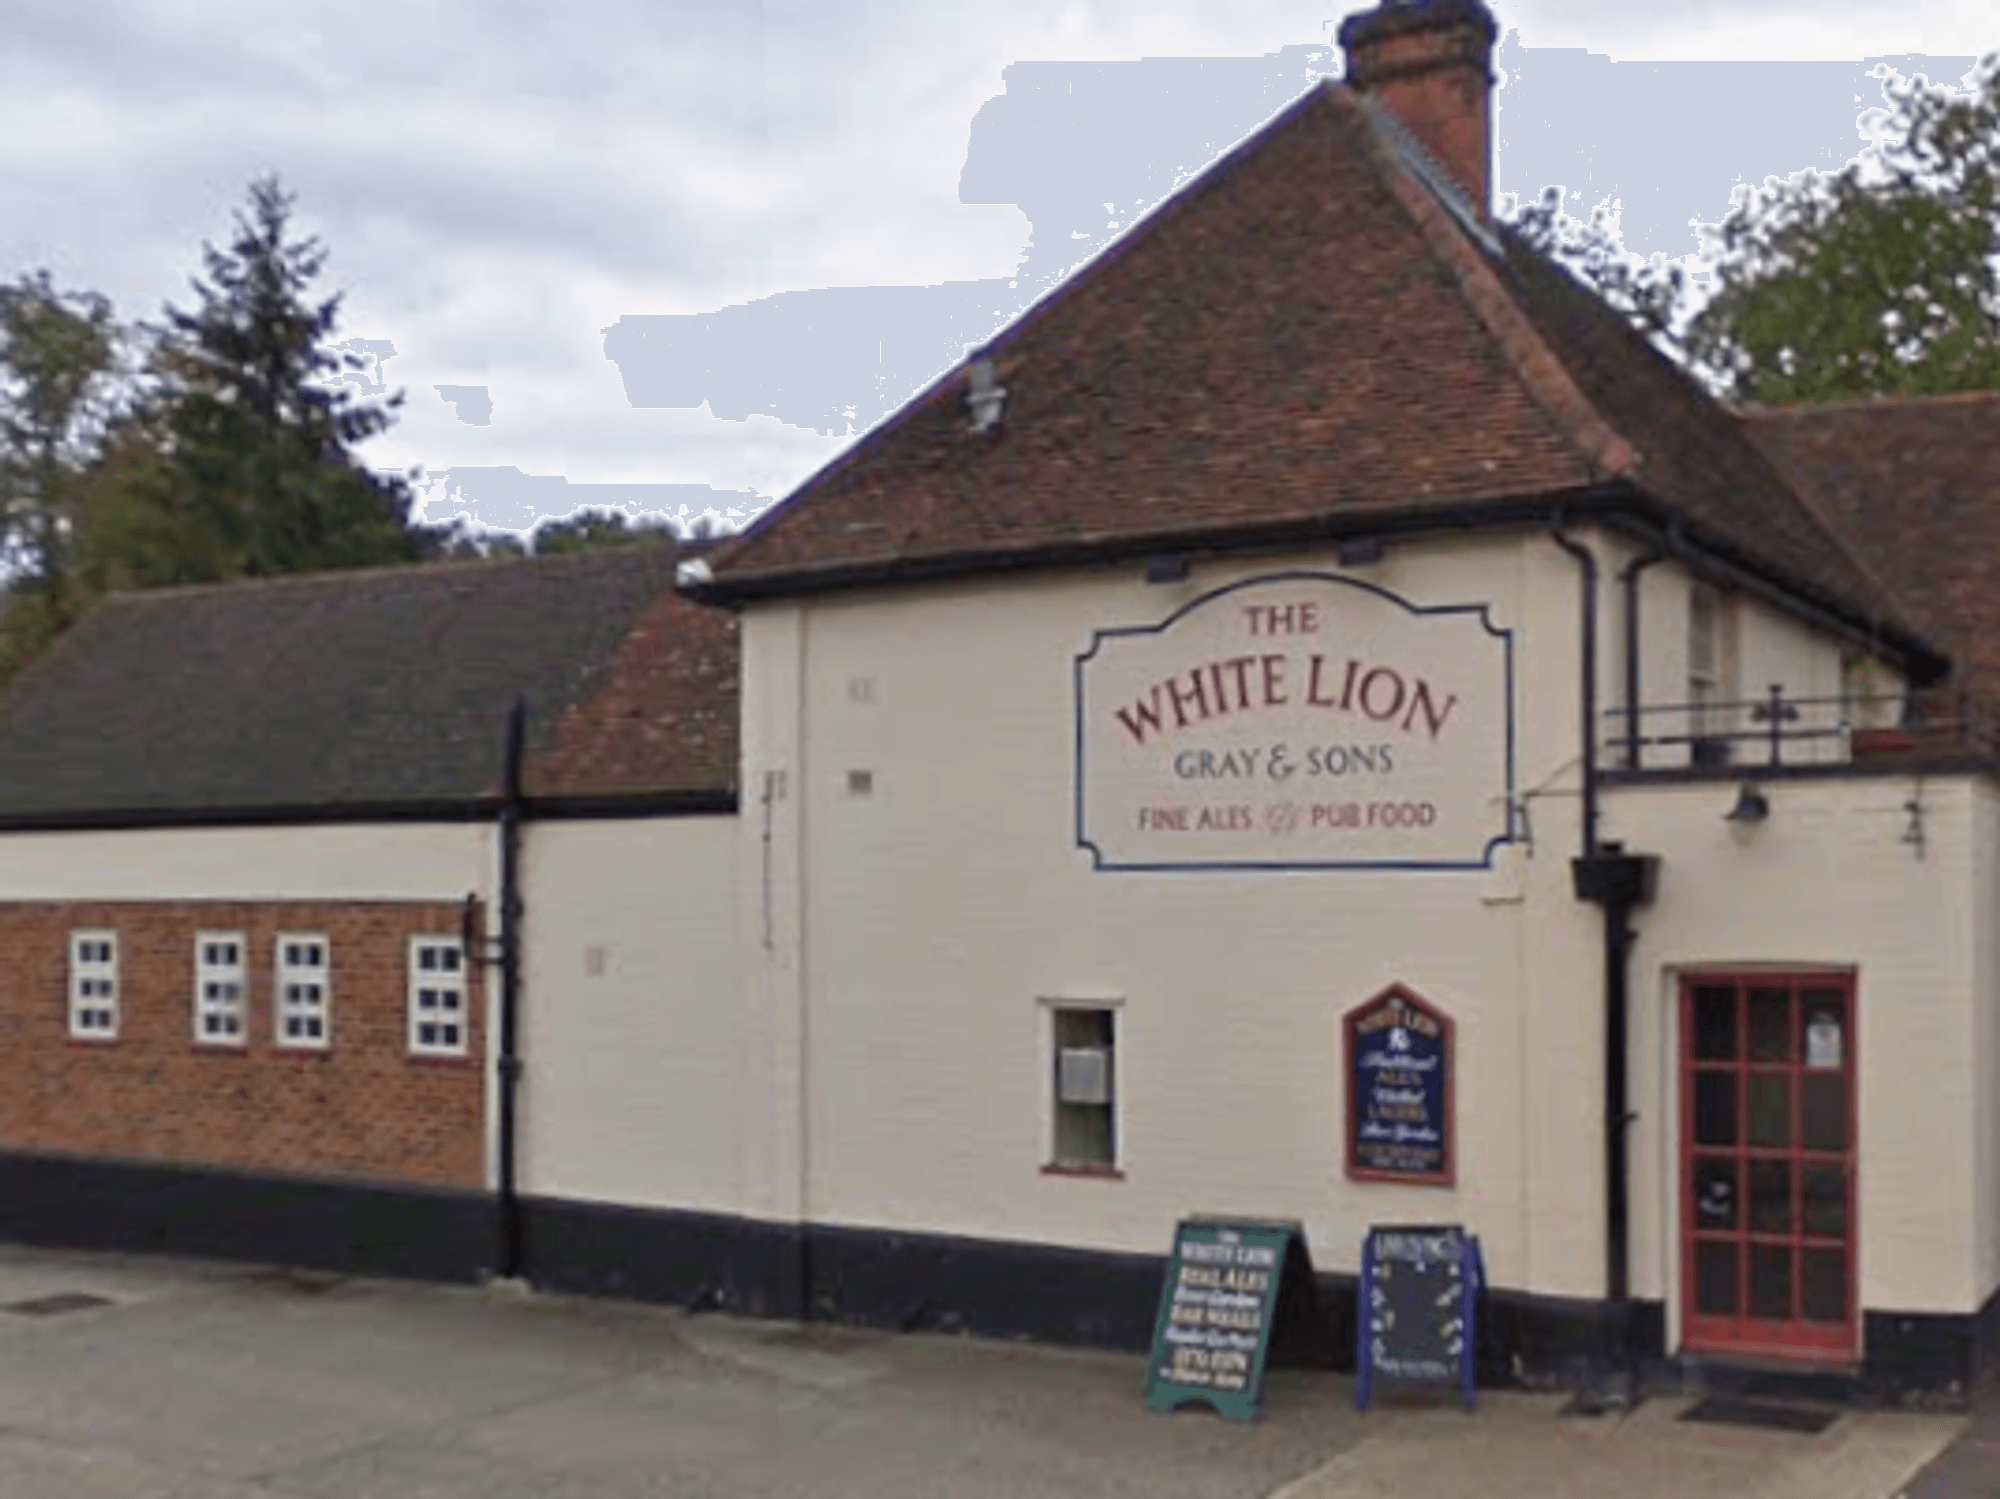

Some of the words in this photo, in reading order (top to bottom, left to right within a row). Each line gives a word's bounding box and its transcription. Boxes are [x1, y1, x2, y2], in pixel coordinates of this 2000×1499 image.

[1244, 603, 1319, 636] THE
[1115, 654, 1288, 745] WHITE
[1306, 655, 1456, 741] LION
[1174, 748, 1261, 779] GRAY
[1267, 745, 1296, 780] &
[1306, 744, 1393, 776] SONS
[1139, 807, 1189, 831] FINE
[1196, 805, 1252, 831] ALES
[1312, 805, 1361, 828] PUB
[1367, 803, 1436, 827] FOOD
